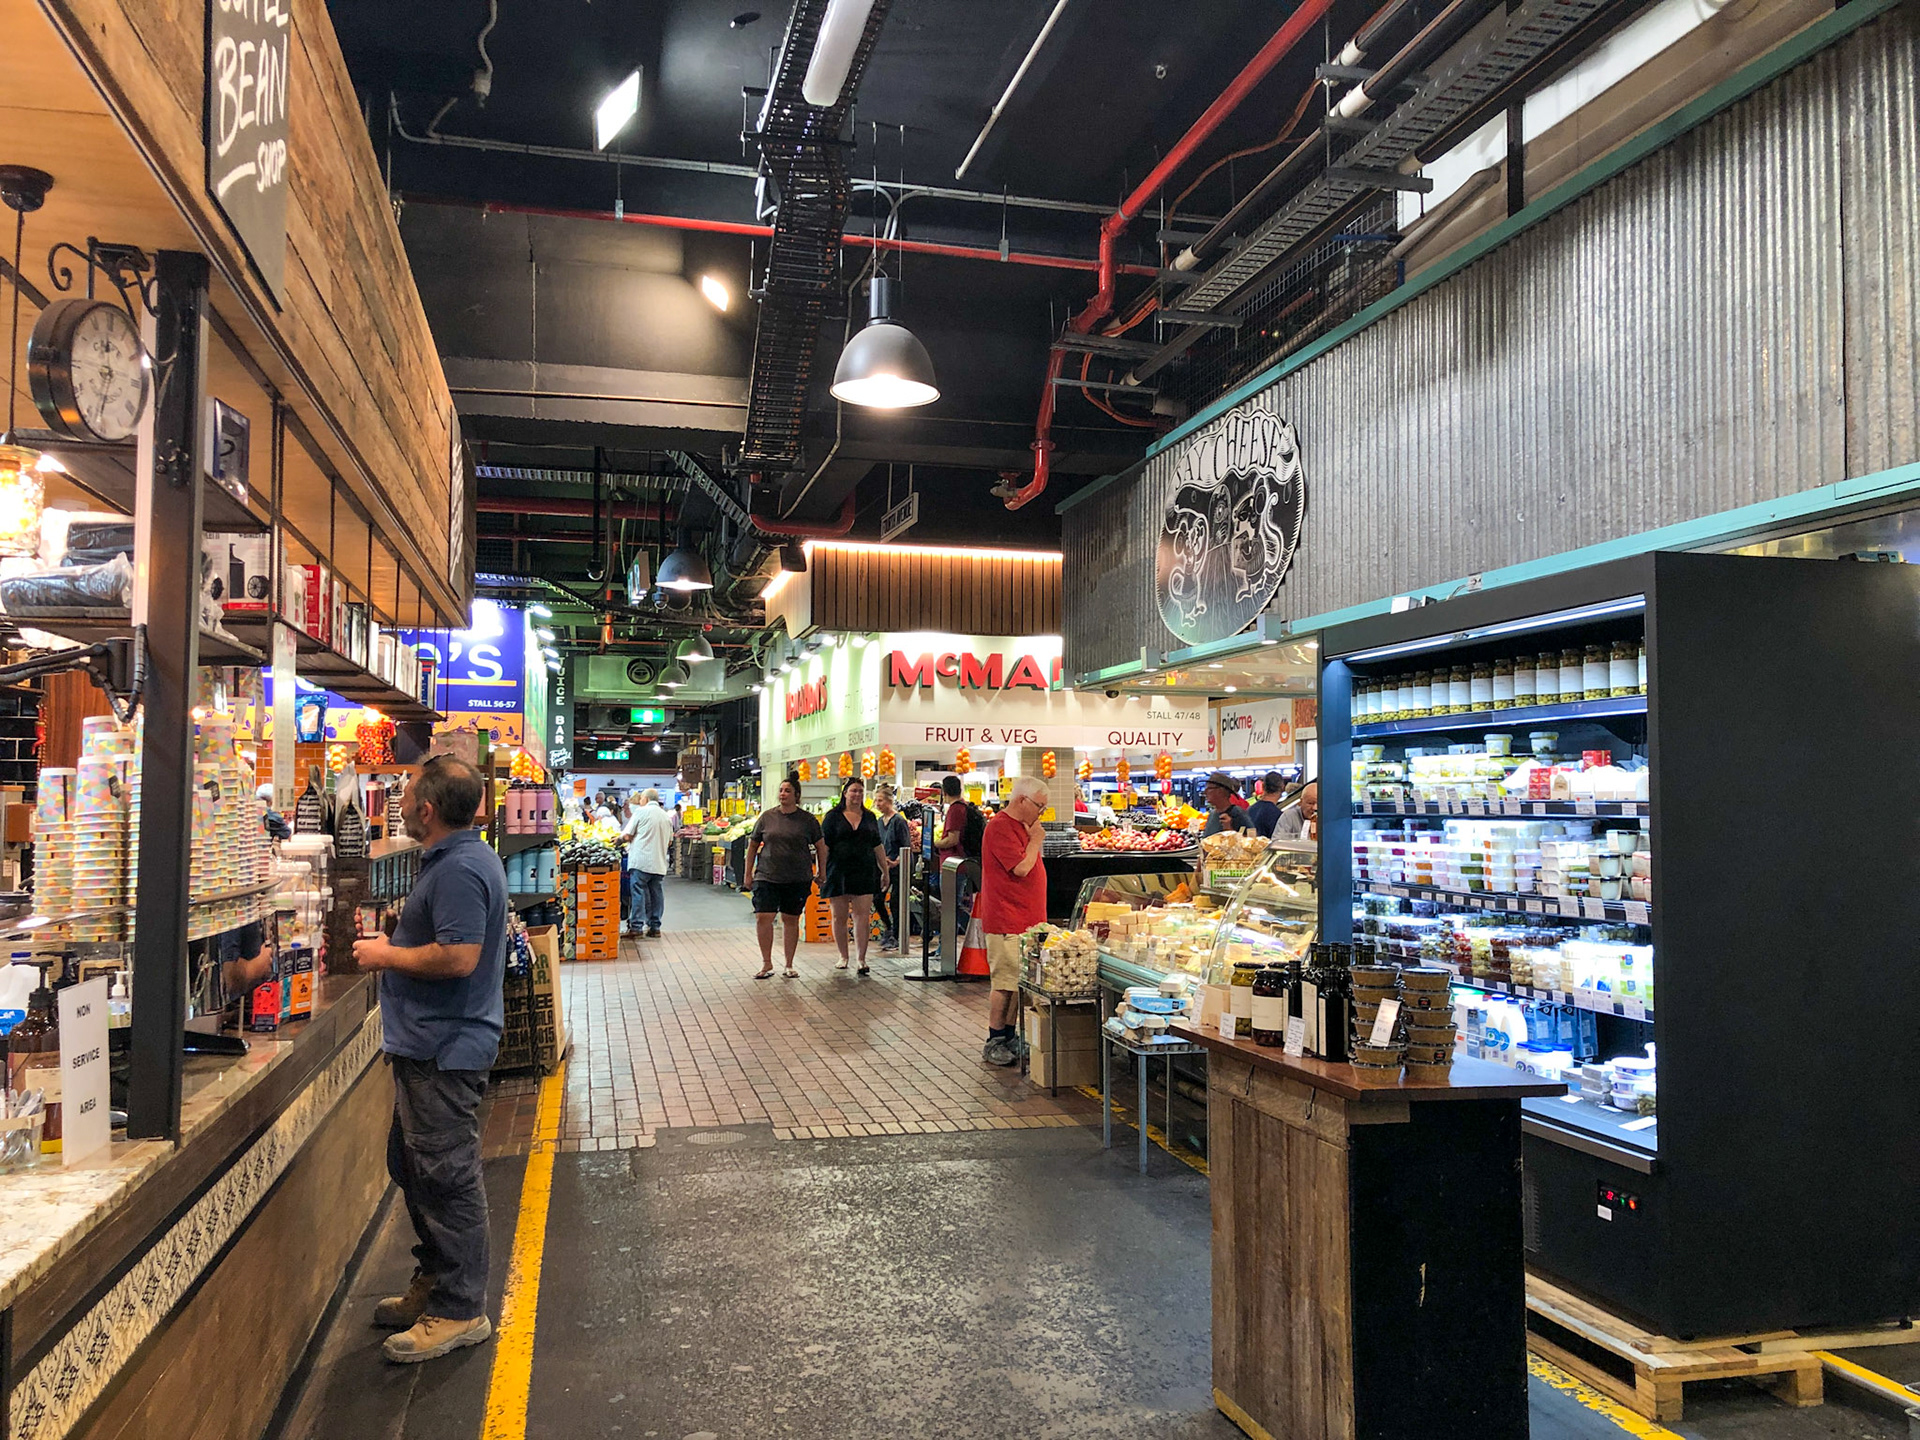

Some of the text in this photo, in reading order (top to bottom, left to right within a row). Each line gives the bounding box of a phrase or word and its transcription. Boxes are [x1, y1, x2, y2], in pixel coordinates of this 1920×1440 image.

[214, 33, 287, 157] BEAN
[256, 138, 287, 193] SHOP
[1174, 415, 1282, 490] SAY CHEESE
[467, 699, 517, 709] STALL 56-57
[1146, 711, 1201, 721] STALL 47/48
[1221, 712, 1253, 737] pickme
[554, 715, 565, 745] BAR
[925, 727, 1038, 743] FRUIT & VEG
[1107, 731, 1184, 746] QUALITY
[1244, 717, 1275, 758] fresh
[76, 1003, 91, 1019] NON
[72, 1047, 100, 1069] SERVICE
[79, 1097, 97, 1115] AREA
